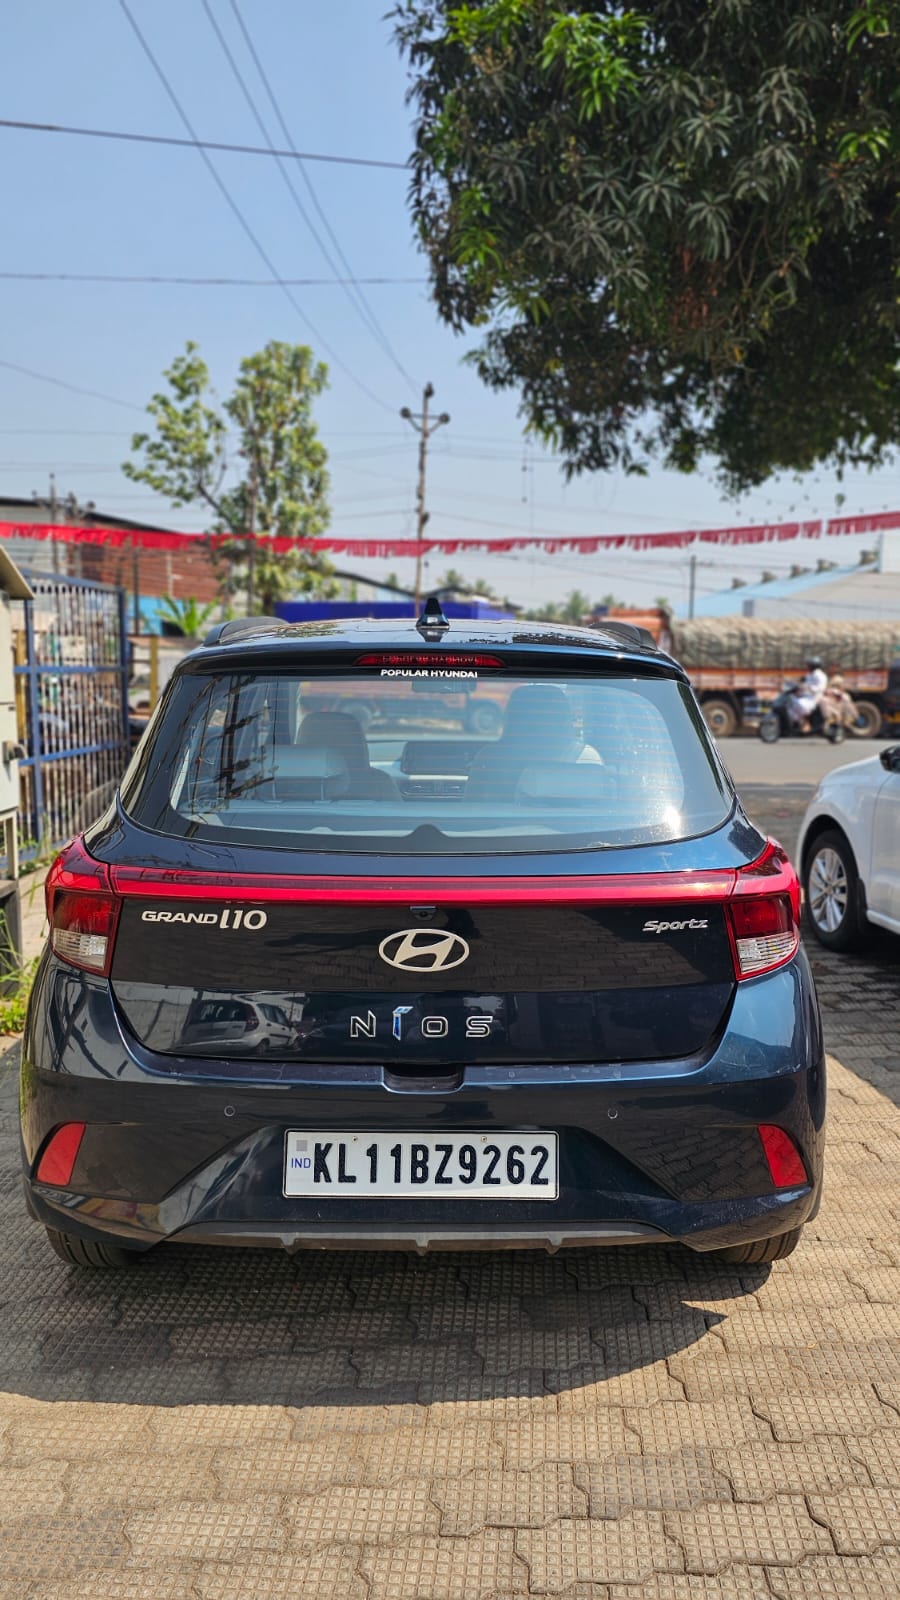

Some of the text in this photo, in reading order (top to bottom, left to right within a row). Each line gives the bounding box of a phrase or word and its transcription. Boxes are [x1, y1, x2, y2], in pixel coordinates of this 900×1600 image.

[380, 669, 478, 679] POPULAR HYUNDAI
[141, 910, 218, 924] GRAND
[642, 918, 709, 934] Sportz
[291, 1157, 311, 1168] IND
[313, 1142, 549, 1185] KL11BZ9262
